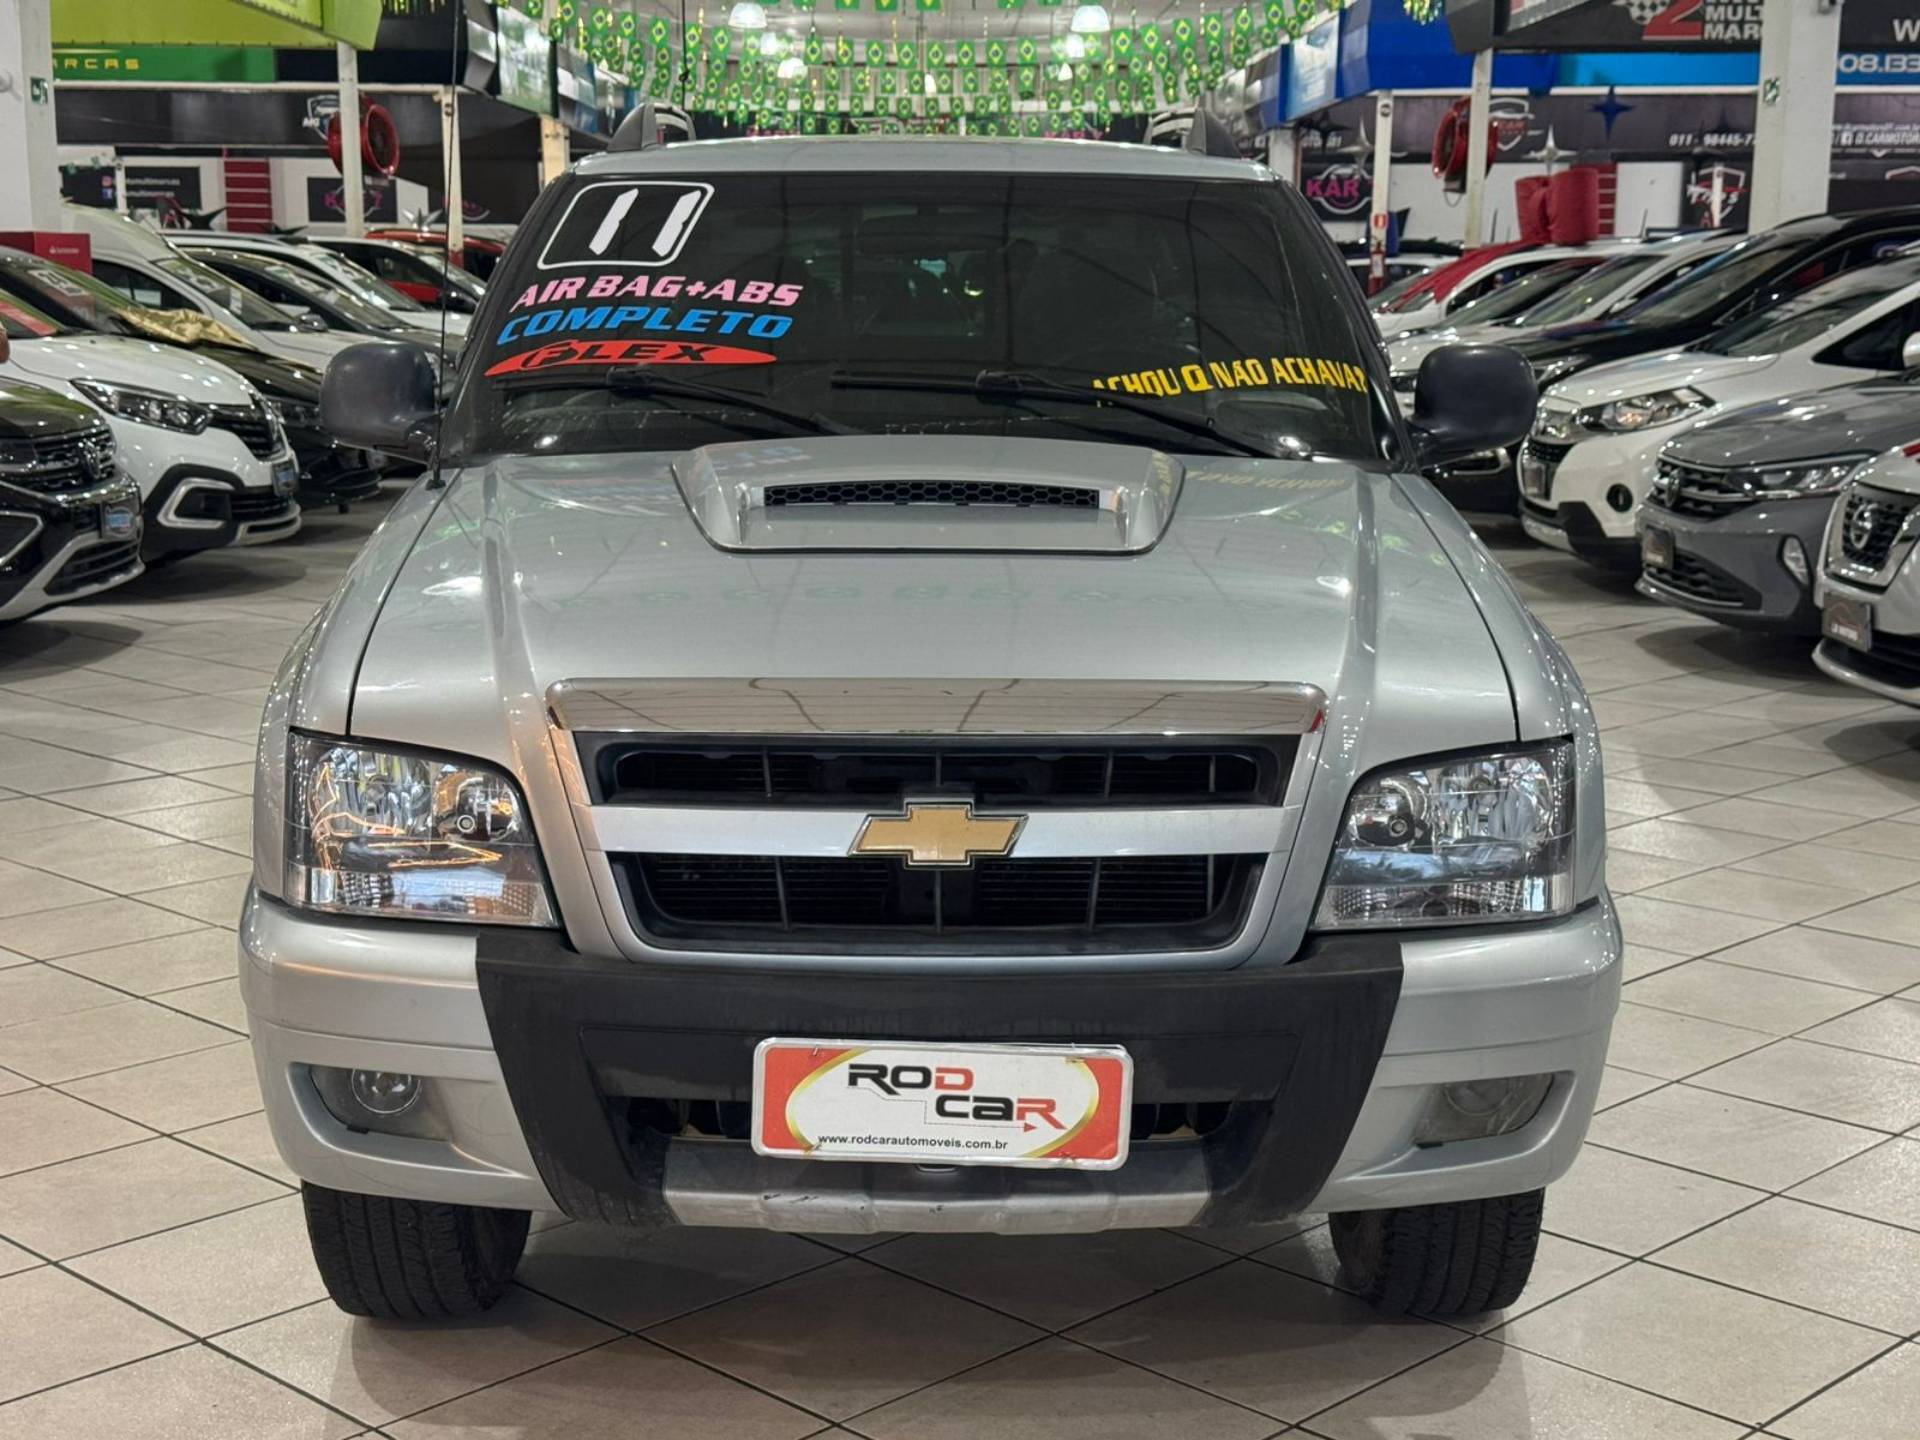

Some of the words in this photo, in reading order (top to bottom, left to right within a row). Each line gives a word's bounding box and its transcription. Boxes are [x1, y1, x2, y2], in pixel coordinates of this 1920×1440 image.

[1306, 178, 1361, 198] KAR
[588, 187, 703, 258] 11
[509, 276, 586, 313] AIR
[586, 274, 804, 308] BAG+ABS
[497, 305, 794, 346] COMPLETO
[521, 340, 716, 371] FLEX
[1182, 364, 1215, 393] Q
[818, 1134, 1009, 1151] www.rodcarautomoveis.com.br
